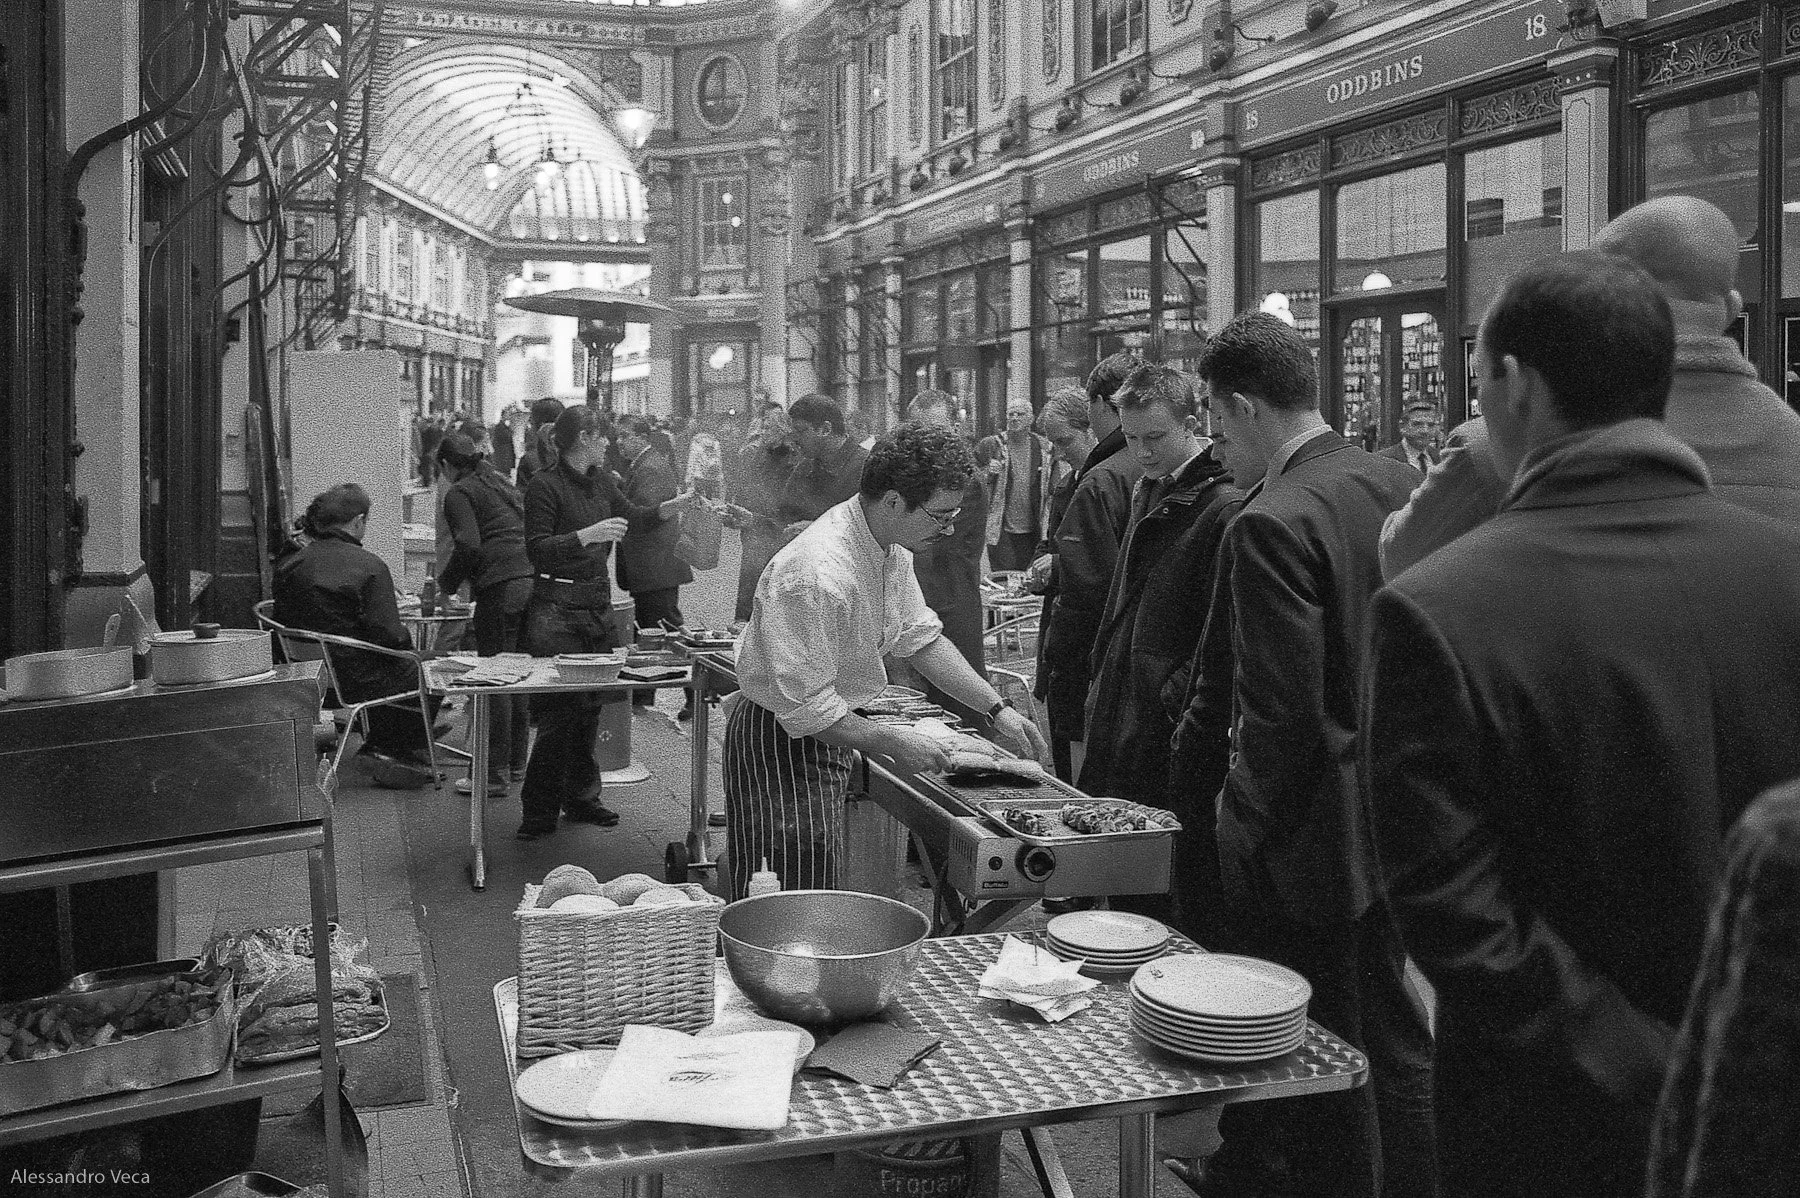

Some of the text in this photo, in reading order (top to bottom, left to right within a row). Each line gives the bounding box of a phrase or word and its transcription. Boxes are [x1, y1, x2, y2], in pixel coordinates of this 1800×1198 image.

[1327, 55, 1422, 103] ODDBINS
[1524, 14, 1547, 41] 18
[1083, 150, 1140, 182] ODDBINS
[880, 1168, 967, 1198] Propan
